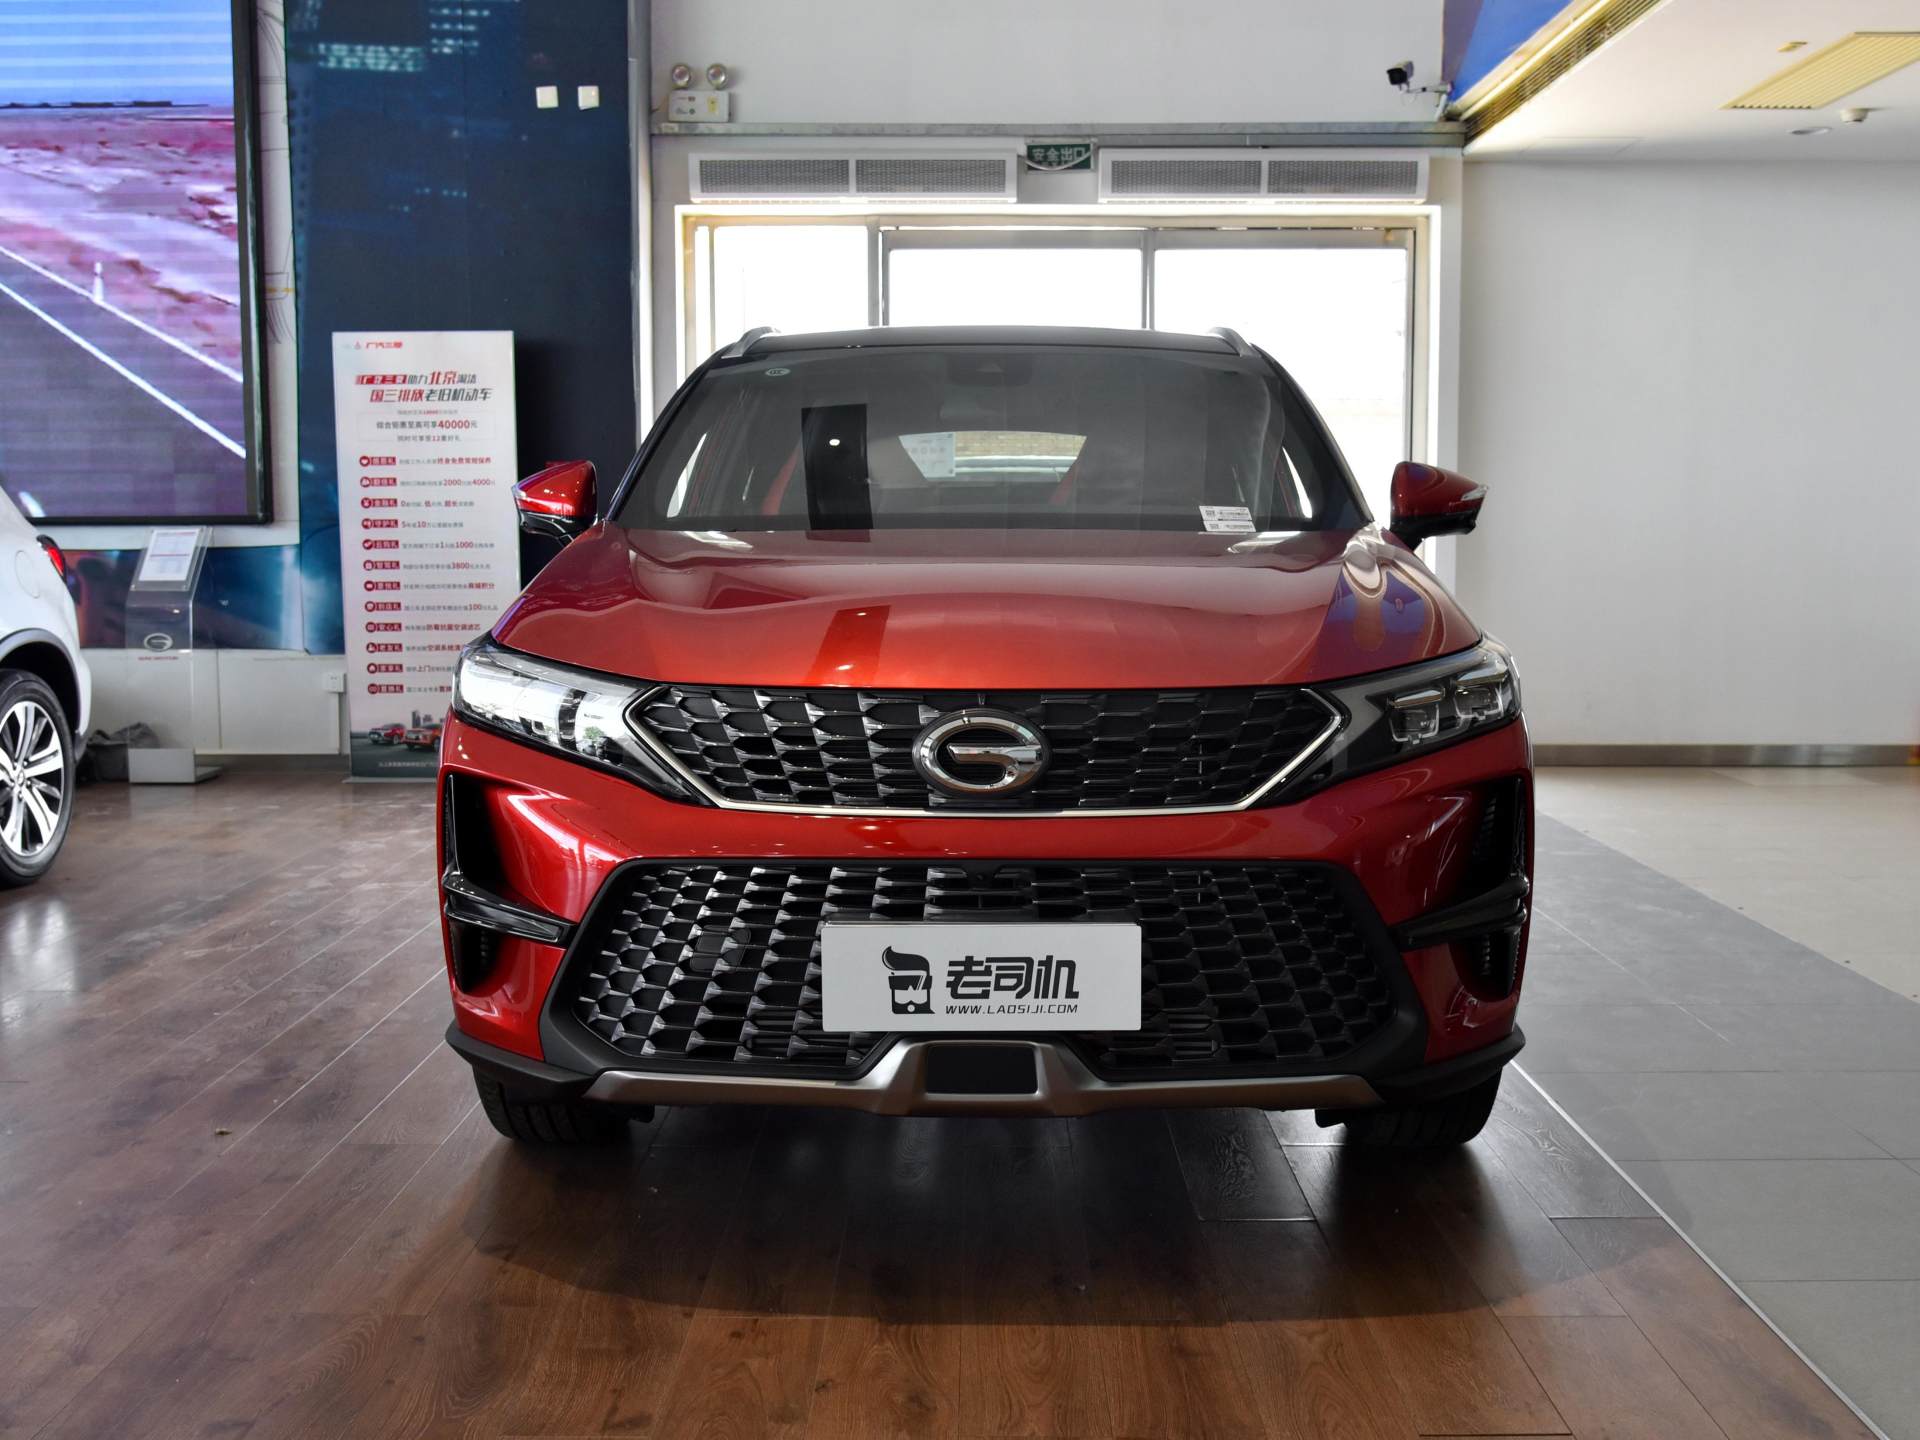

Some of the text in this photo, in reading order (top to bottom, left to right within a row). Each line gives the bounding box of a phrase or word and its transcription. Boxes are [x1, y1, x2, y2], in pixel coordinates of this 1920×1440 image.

[1032, 147, 1086, 161] 安全出口
[370, 388, 492, 402] 国三排放老旧机动车
[945, 955, 1079, 999] 老司机
[945, 1004, 1078, 1014] WWW.LAOSIJI.COM
